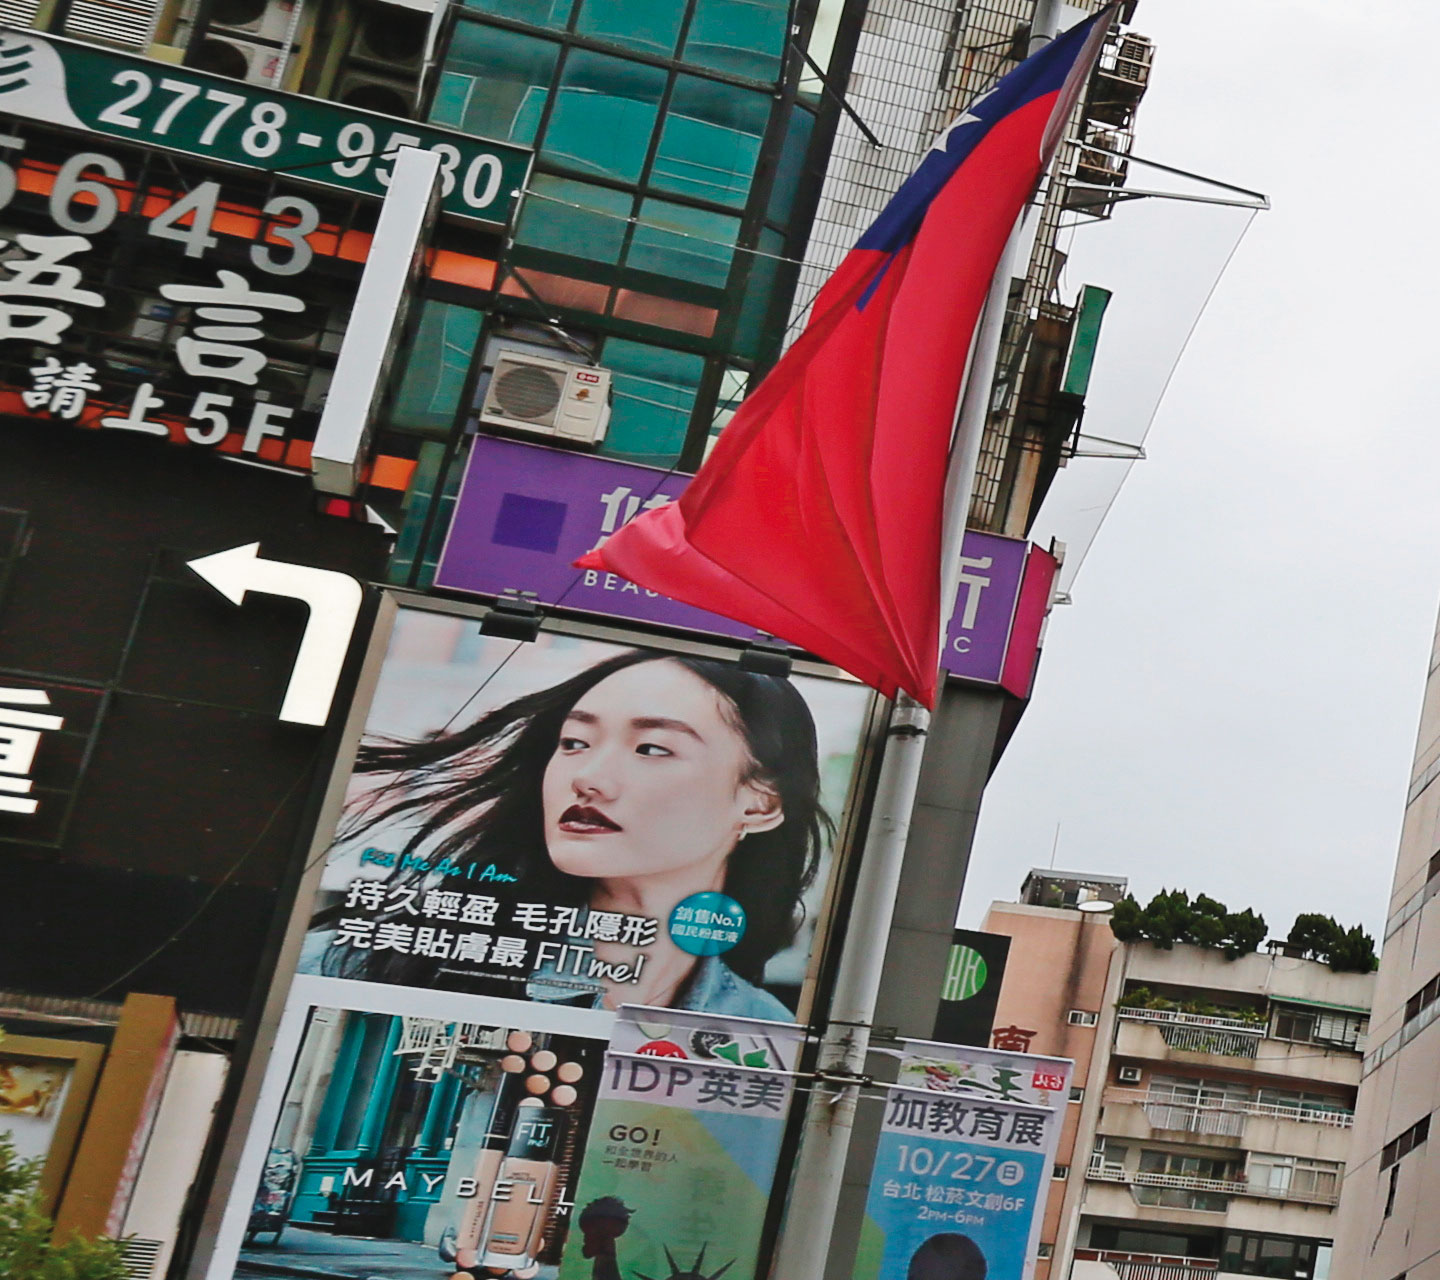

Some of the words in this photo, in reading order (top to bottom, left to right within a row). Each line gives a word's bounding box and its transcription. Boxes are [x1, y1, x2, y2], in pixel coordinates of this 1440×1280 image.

[345, 879, 500, 927] 持久輕盈
[511, 902, 660, 947] 毛孔隱形
[887, 1094, 1047, 1146] 加教育展
